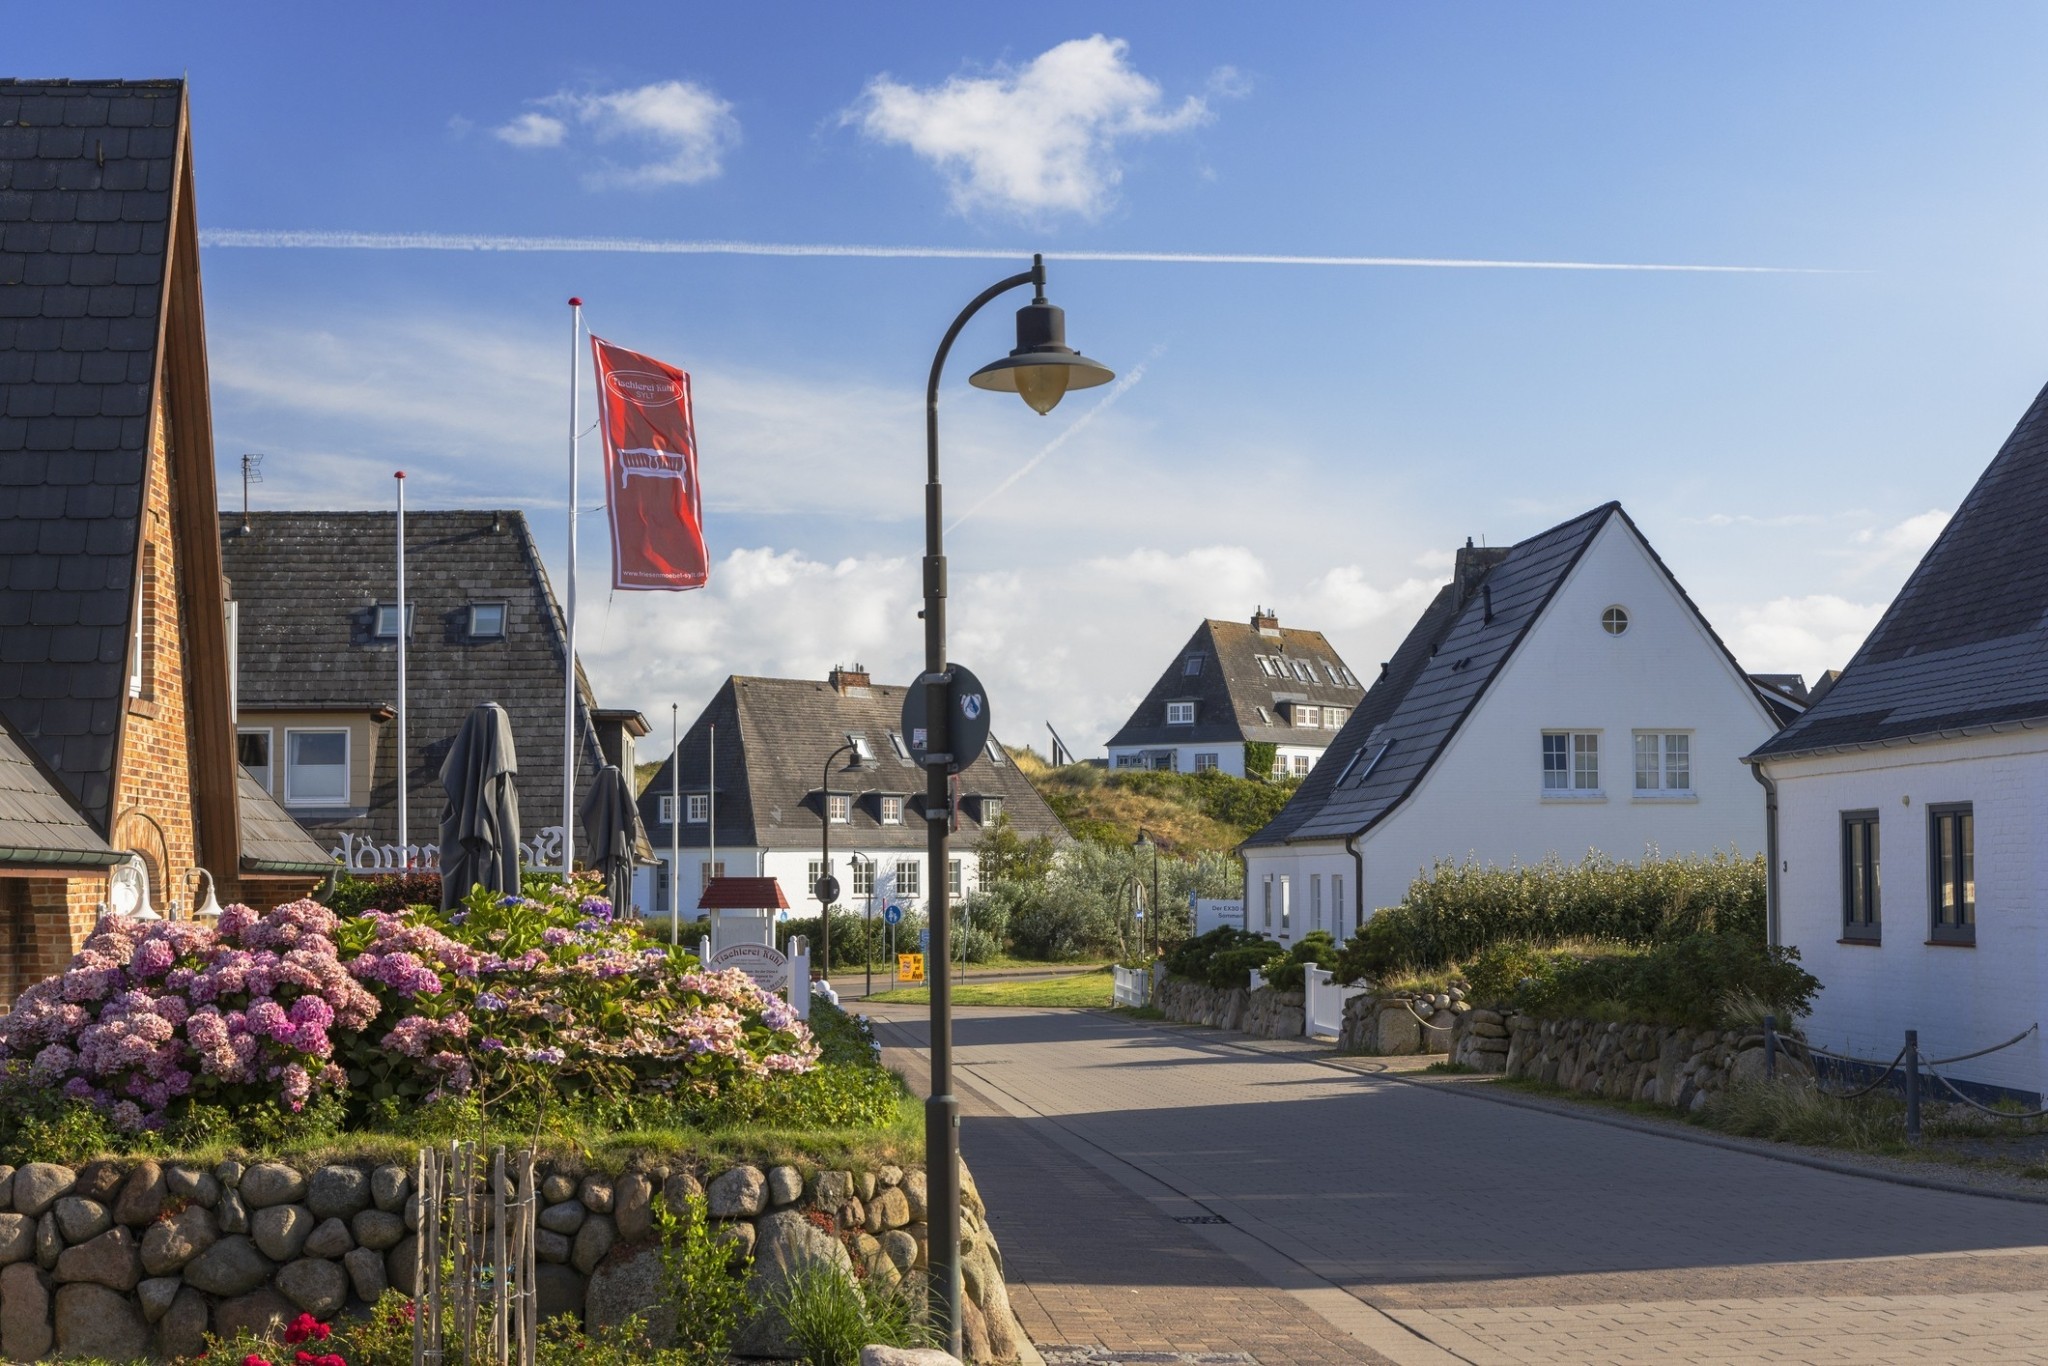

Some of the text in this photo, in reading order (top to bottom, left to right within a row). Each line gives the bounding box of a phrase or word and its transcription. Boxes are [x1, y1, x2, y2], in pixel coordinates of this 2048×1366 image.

[635, 391, 654, 399] SYLT
[1783, 860, 1788, 873] 3
[714, 948, 760, 965] Tischlerei
